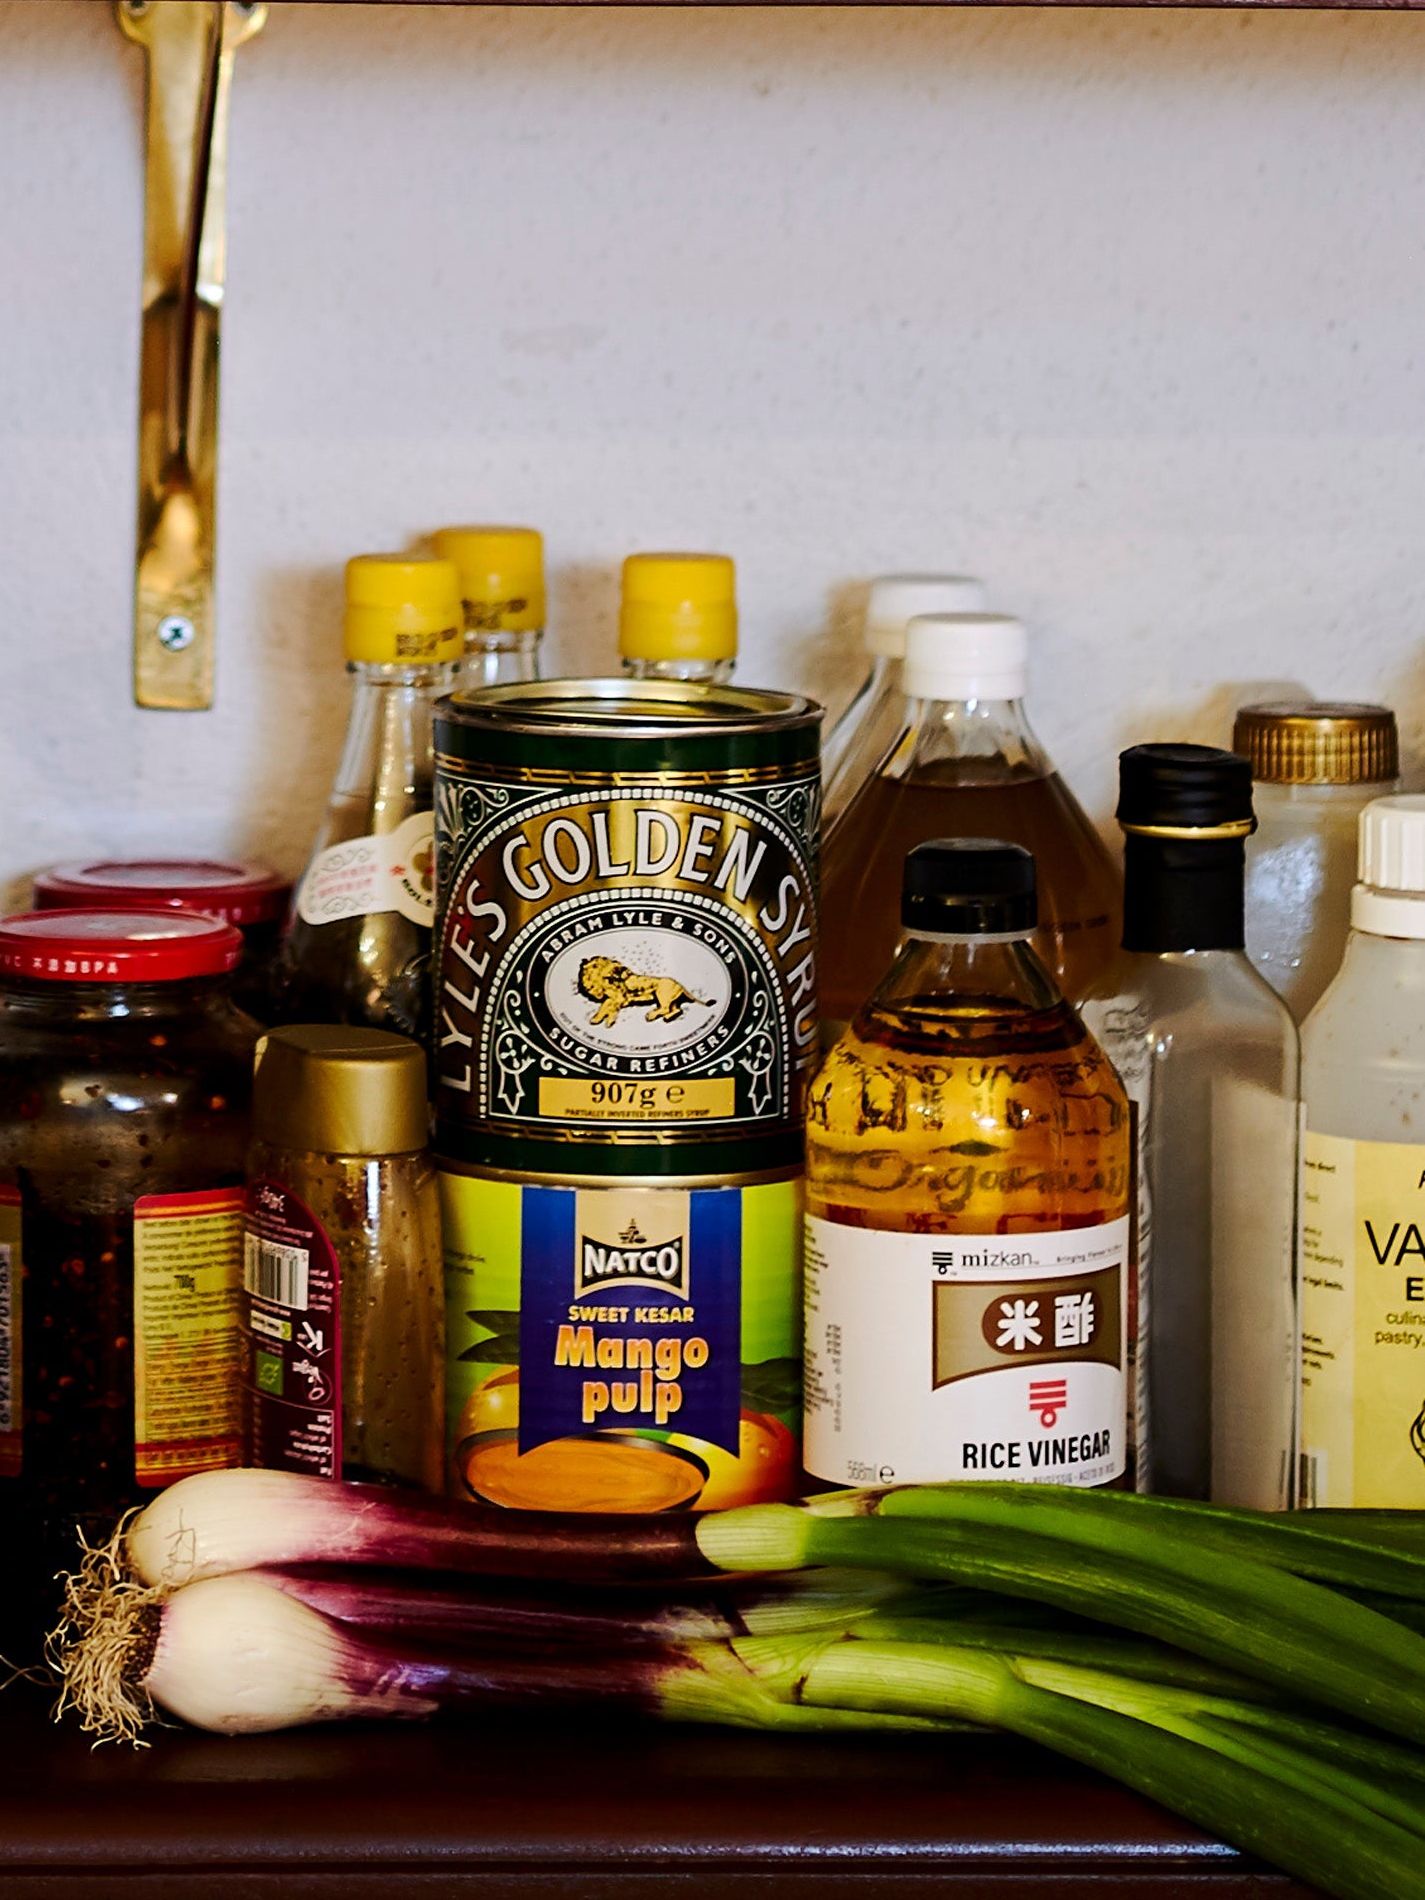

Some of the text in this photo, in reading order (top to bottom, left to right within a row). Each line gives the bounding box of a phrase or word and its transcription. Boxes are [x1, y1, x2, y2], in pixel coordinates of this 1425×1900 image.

[441, 879, 507, 1092] LYLE'S
[502, 809, 767, 902] GOLDEN
[540, 912, 737, 965] ABRAM LYLE & SONS
[549, 1024, 730, 1073] SUGAR REFINERS
[565, 1109, 605, 1118] PARTIALLY
[590, 1081, 655, 1109] 907g
[583, 1243, 678, 1280] NATCO
[962, 1249, 1033, 1268] mizkan
[568, 1306, 694, 1324] SWEET KESAR
[996, 1291, 1095, 1351] 米酢
[554, 1325, 709, 1381] Mango
[582, 1370, 683, 1425] pulp
[962, 1429, 1110, 1470] RICE VINEGAR
